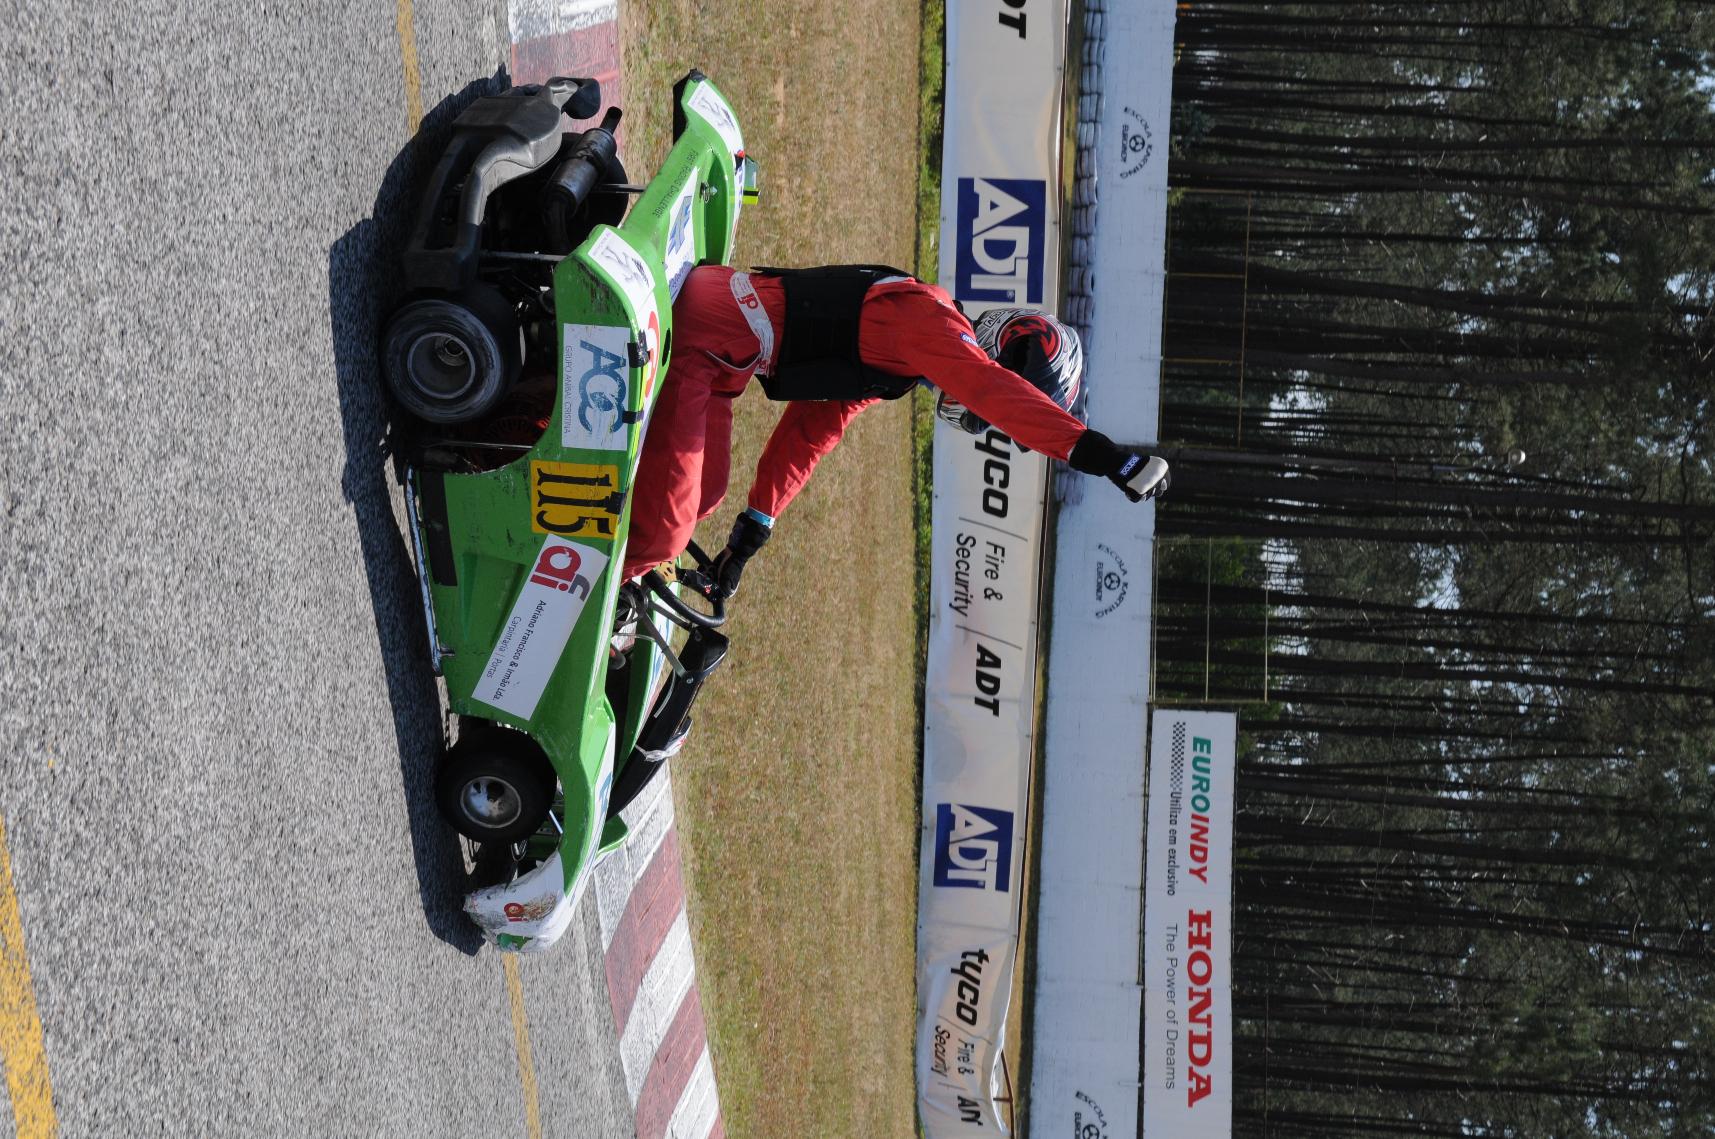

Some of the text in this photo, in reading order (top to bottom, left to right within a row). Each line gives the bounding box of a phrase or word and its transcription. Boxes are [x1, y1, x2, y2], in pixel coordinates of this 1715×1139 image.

[970, 178, 1030, 304] ADT
[564, 346, 572, 372] GRUPO
[564, 401, 572, 434] CRISTINA
[536, 468, 613, 535] 115
[974, 430, 1012, 518] yco
[948, 533, 976, 617] Security
[984, 541, 1006, 601] Fire &
[498, 616, 522, 652] Carpintaria
[512, 629, 534, 660] Francisco
[528, 600, 547, 628] Adriano
[486, 658, 502, 679] Portas
[492, 688, 506, 700] Lda.
[500, 668, 514, 688] Irmão
[974, 644, 1002, 718] ADT
[1188, 736, 1212, 884] EUROINDY
[947, 804, 999, 891] ADT
[1167, 791, 1182, 896] Utiliza em exclusivo
[951, 949, 990, 1026] tyco
[1166, 924, 1178, 1090] The Power of Dreams
[1187, 909, 1212, 1108] HONDA
[931, 1026, 951, 1078] Security
[958, 1039, 975, 1062] Fire
